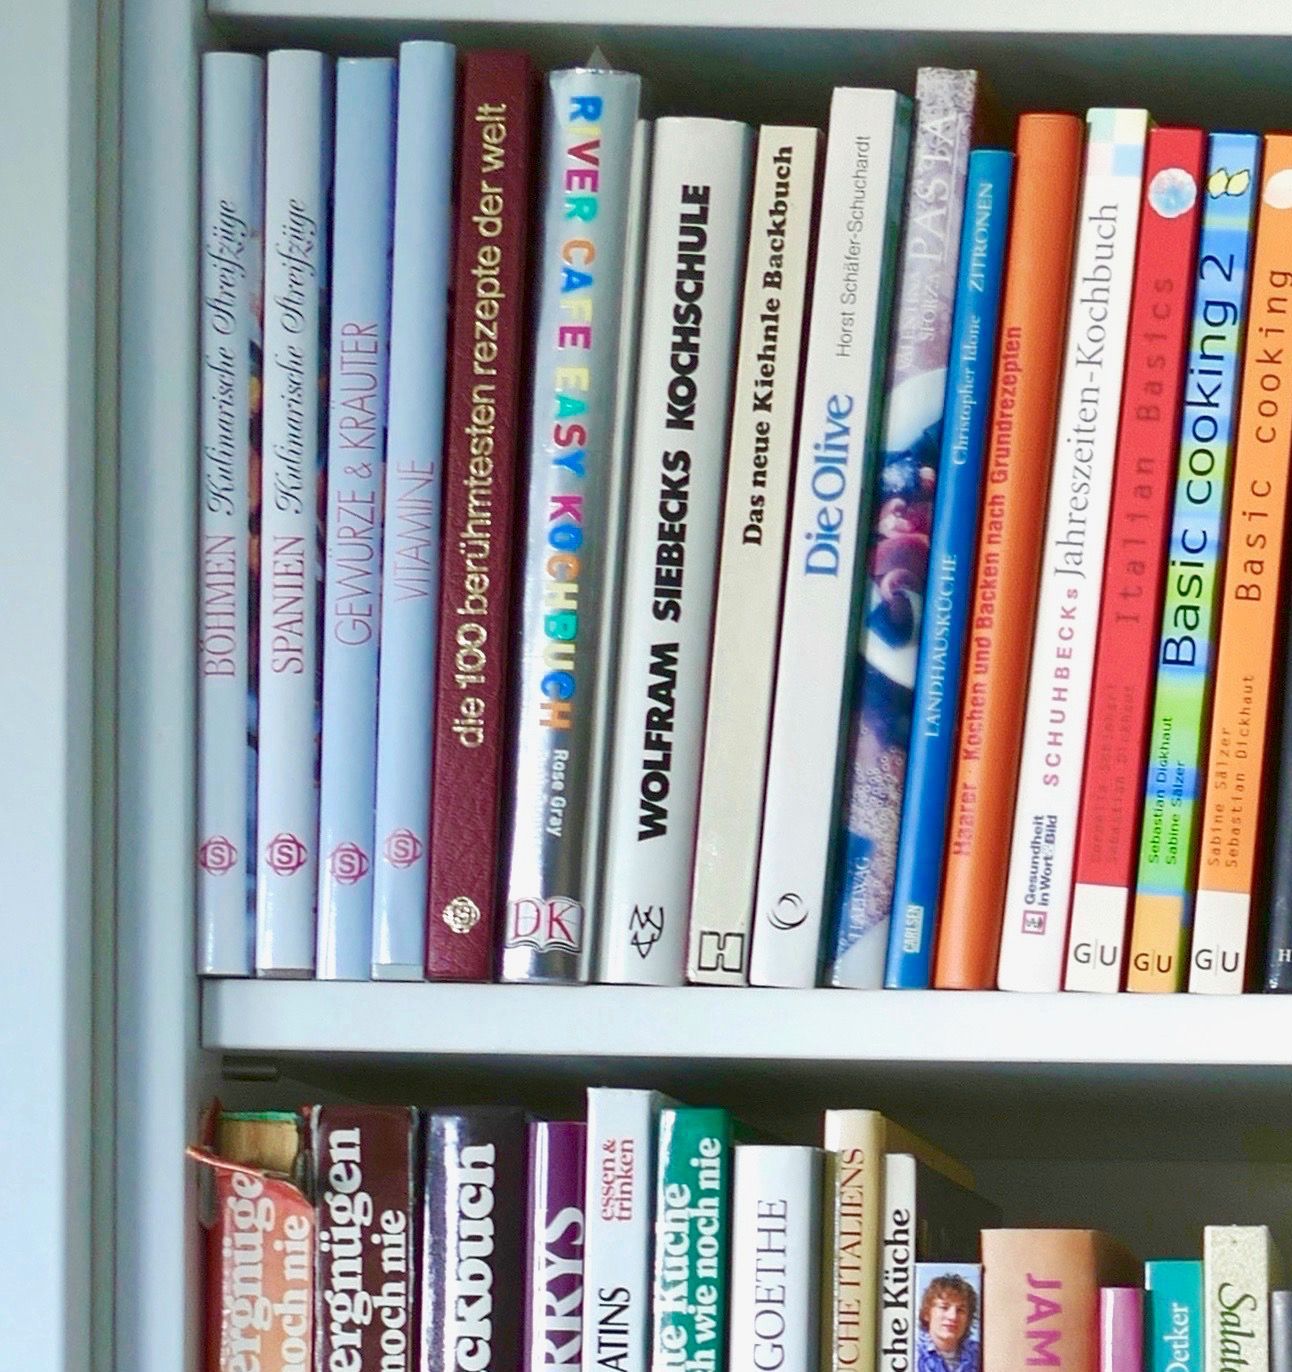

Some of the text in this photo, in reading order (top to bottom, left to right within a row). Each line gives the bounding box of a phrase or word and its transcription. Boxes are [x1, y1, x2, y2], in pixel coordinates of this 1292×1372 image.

[203, 200, 247, 678] BÖHMEN Kulinarische Streifzüge
[336, 323, 379, 450] KRÄUTER
[393, 460, 434, 601] VITAMINE
[453, 104, 506, 746] die 100 berühmtesten rezepte der welt
[639, 185, 709, 840] WOLFRAM SIEBECKS KOCHSCHULE
[744, 147, 792, 544] Das neue Kiehnle Backbuch
[806, 136, 870, 575] Die Olive Horst Schäfer-Schuchardt
[1056, 207, 1124, 585] Jahreszeiten-Kochbuch
[1161, 253, 1237, 669] Basic cooking 2
[331, 490, 374, 646] GEWÜRZE
[755, 1200, 787, 1365] GOETHE
[883, 1210, 910, 1310] Küche
